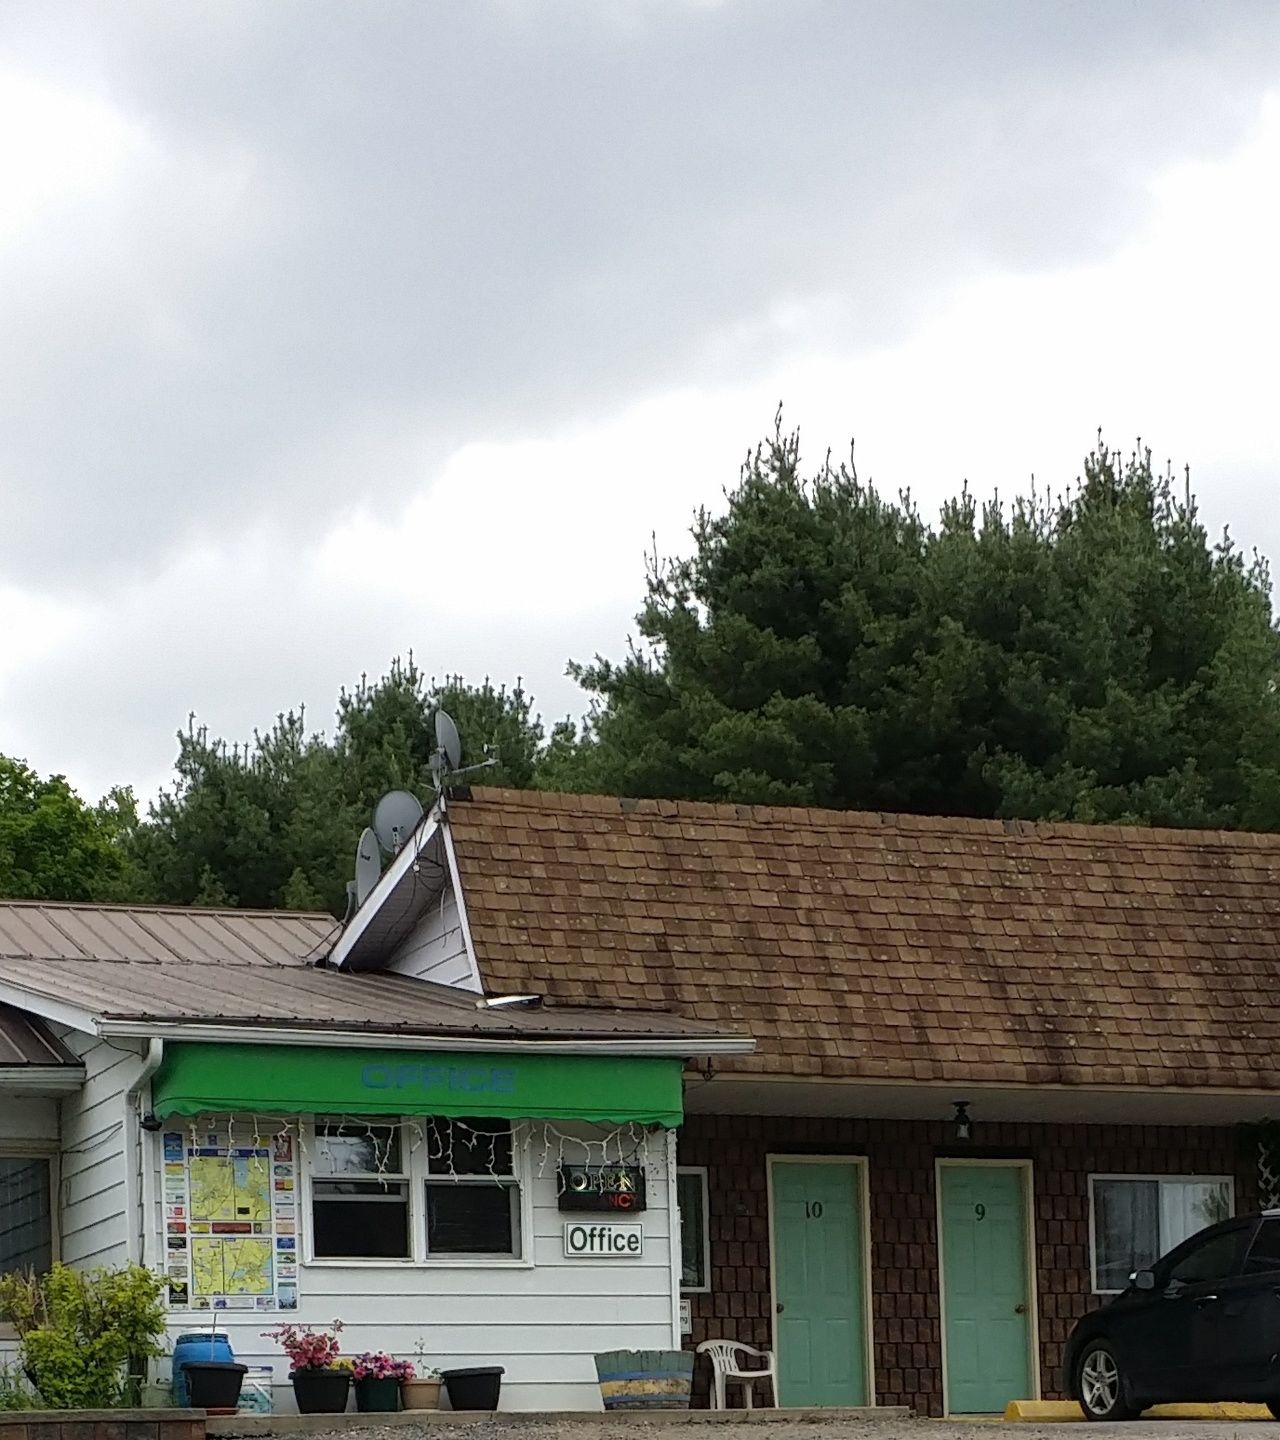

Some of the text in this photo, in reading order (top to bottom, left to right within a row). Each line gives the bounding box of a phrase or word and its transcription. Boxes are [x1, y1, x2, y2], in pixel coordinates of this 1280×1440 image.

[362, 1063, 515, 1093] OFFICE
[569, 1172, 637, 1192] OPEN
[805, 1200, 823, 1219] 10
[974, 1203, 986, 1221] 9
[569, 1226, 640, 1252] Office
